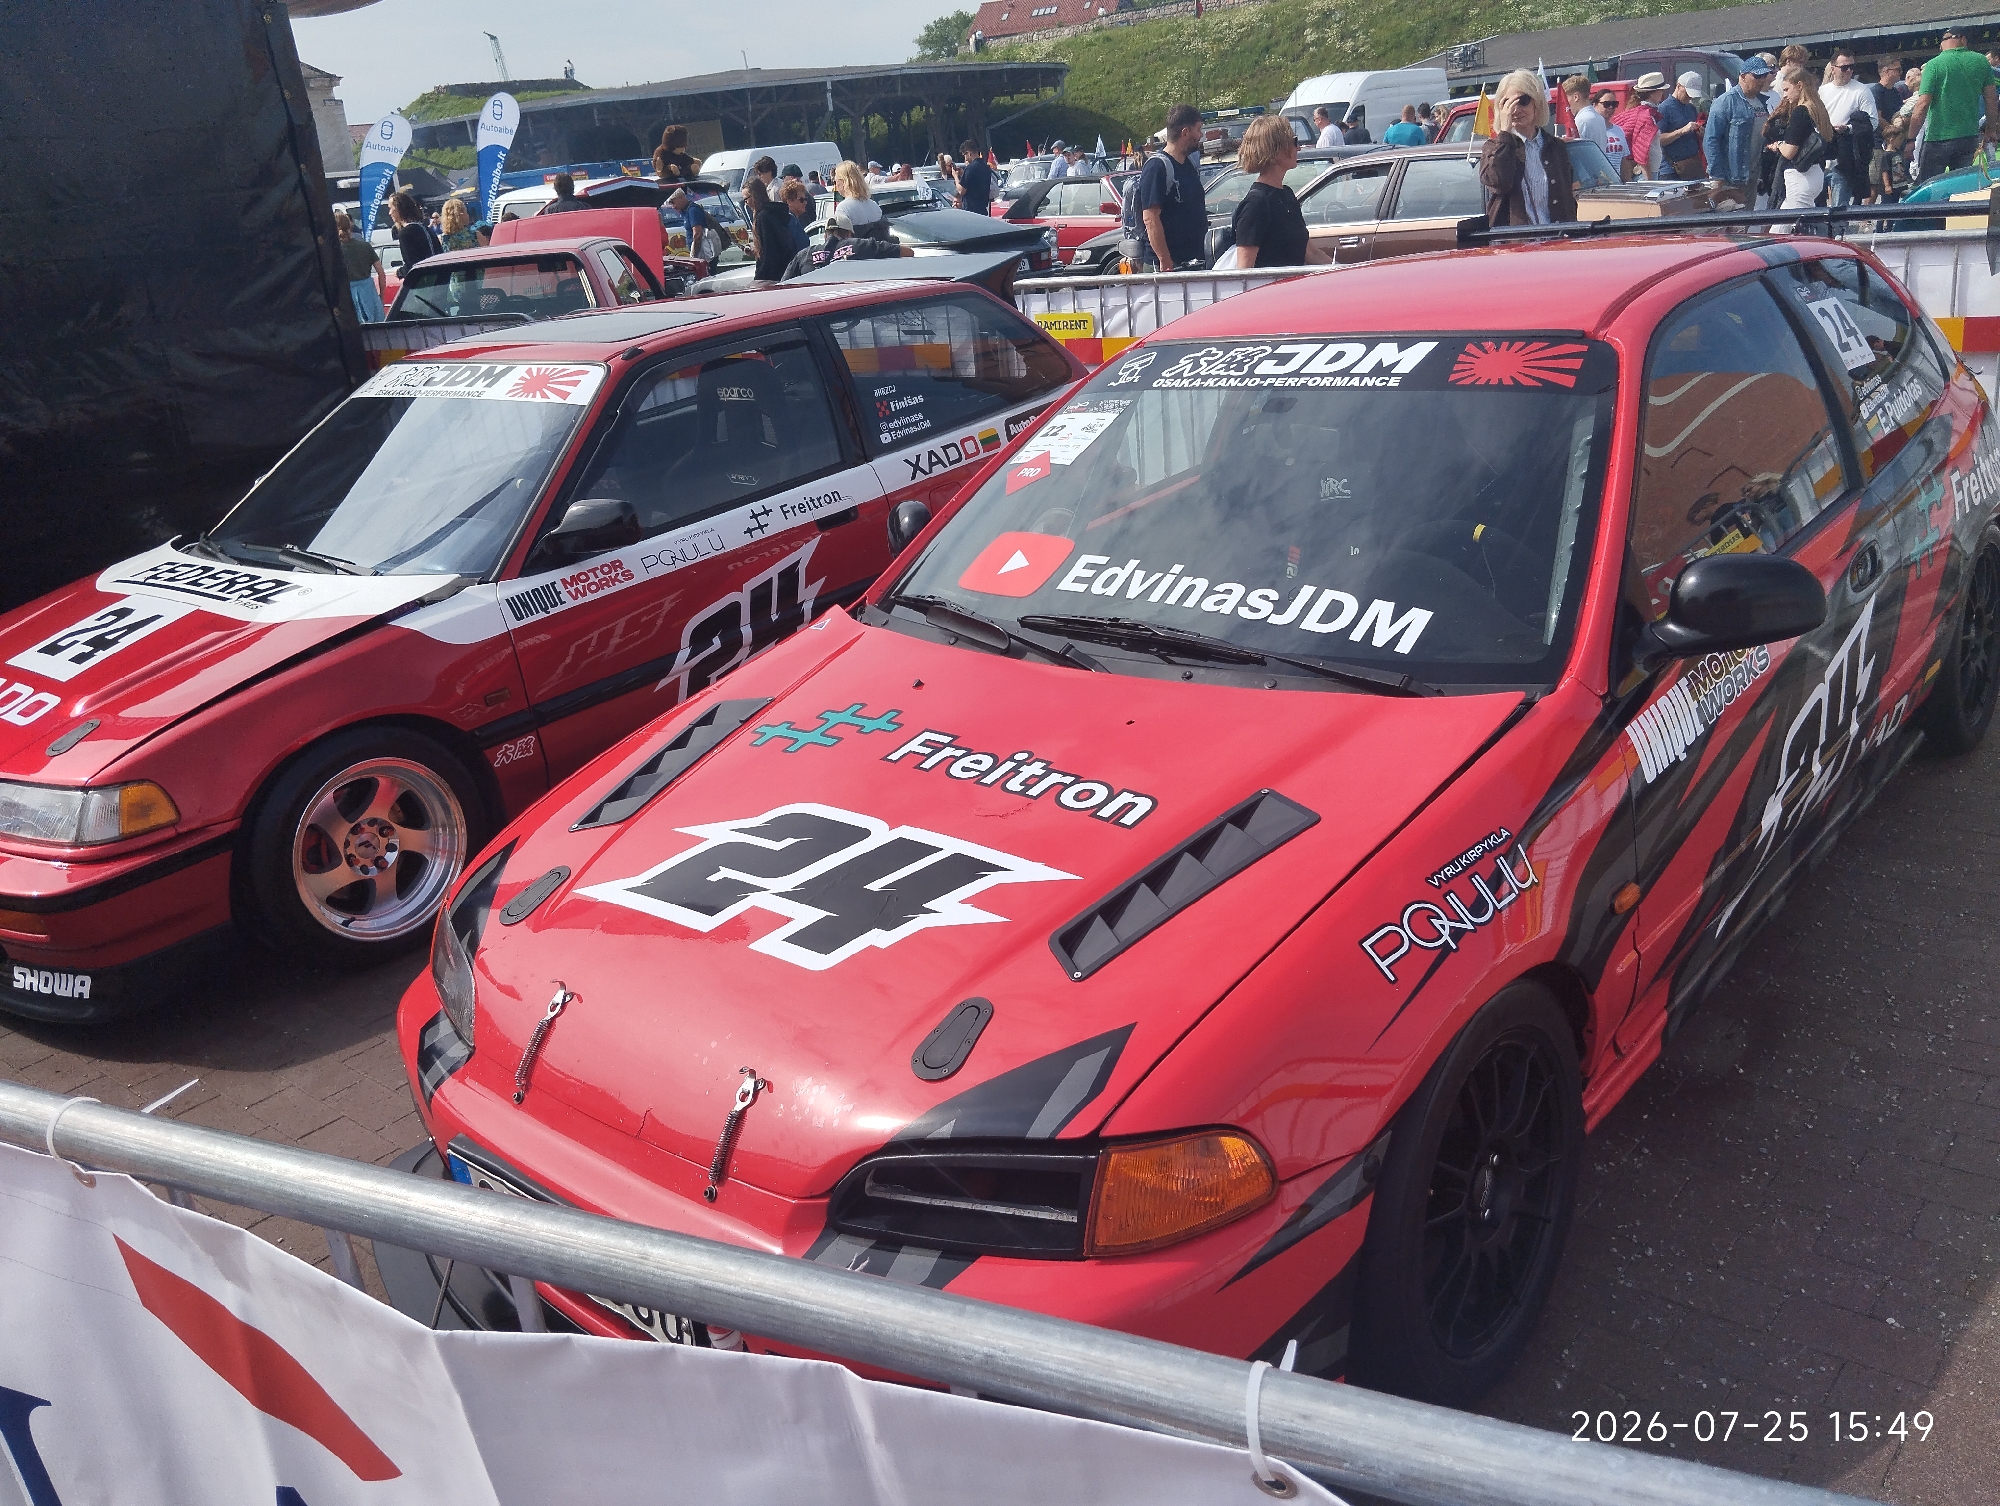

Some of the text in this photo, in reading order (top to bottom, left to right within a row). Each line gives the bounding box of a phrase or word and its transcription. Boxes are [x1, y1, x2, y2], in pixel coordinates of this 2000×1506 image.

[1817, 304, 1864, 353] 24
[423, 365, 517, 389] JDM
[1253, 342, 1440, 375] JDM
[1152, 376, 1402, 388] OSAKA-KANJO-PERFORMANCE
[903, 435, 980, 481] XADO
[1017, 467, 1042, 477] PRO
[779, 489, 845, 521] Freitron
[140, 561, 295, 604] FEDERAL
[560, 558, 625, 588] MOTOR
[565, 570, 635, 601] WORKS
[505, 581, 566, 622] UNIQUE
[1056, 554, 1434, 655] EdvinasJDM
[37, 607, 164, 665] 24
[1699, 644, 1770, 725] WORKS
[1624, 676, 1705, 784] UNIQUE
[885, 728, 1157, 829] Freitron
[572, 802, 1085, 971] 24
[13, 965, 92, 999] SHOWA
